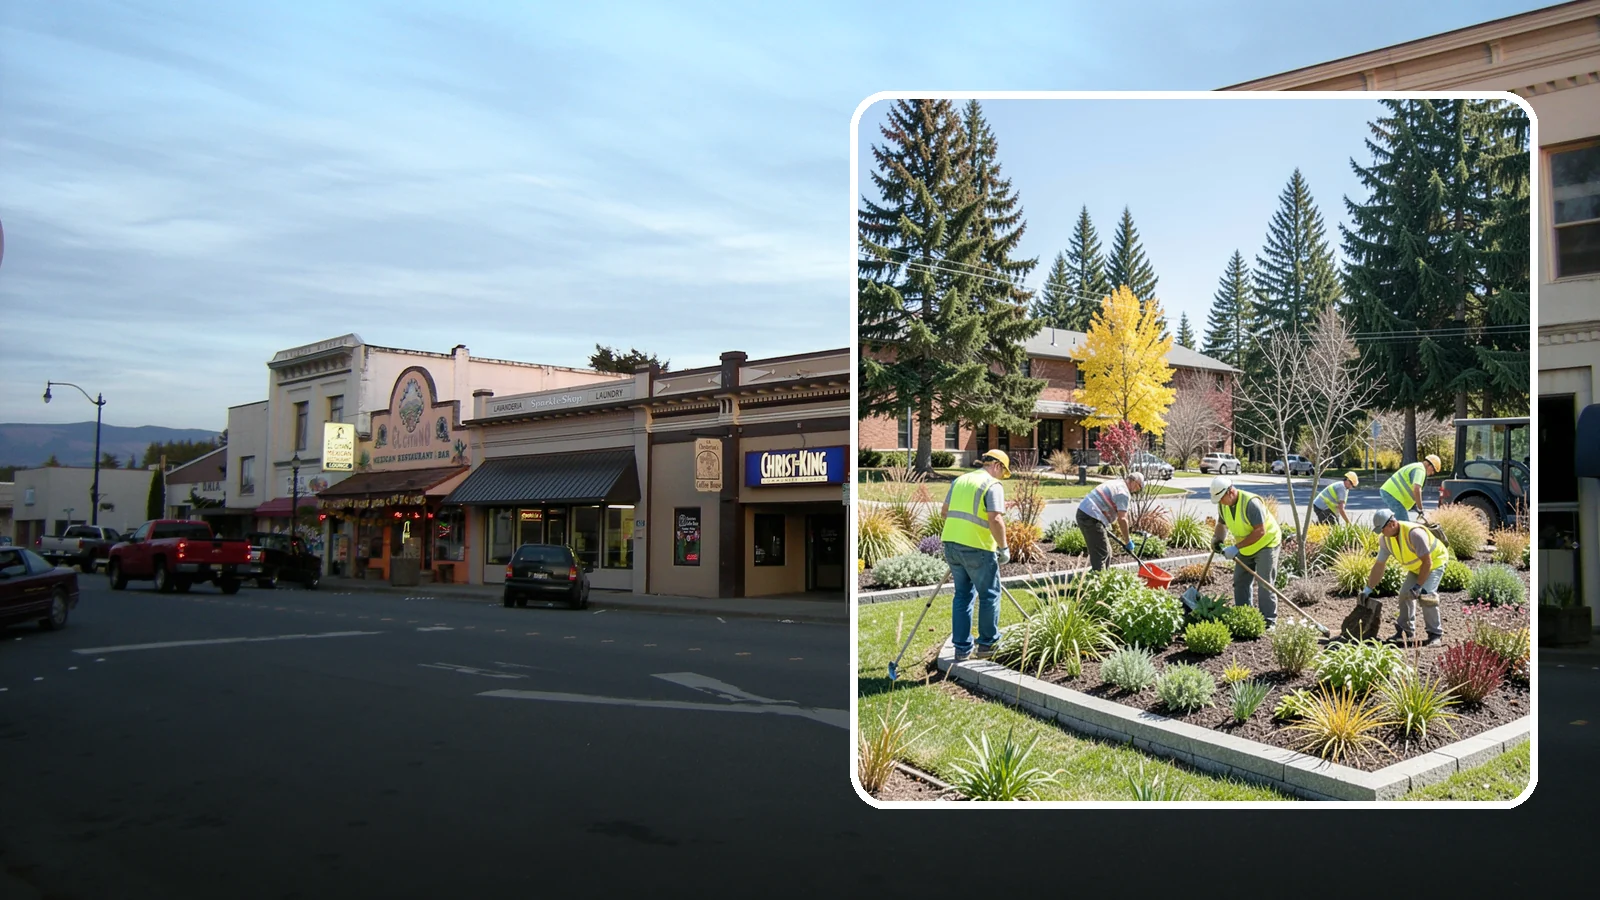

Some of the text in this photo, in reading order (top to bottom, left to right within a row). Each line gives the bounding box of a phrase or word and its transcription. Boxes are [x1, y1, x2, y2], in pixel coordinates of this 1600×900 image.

[493, 389, 623, 412] LAVANDERIA Sparkle Shop LAUNDRY
[373, 454, 396, 464] MEXICAN
[397, 451, 433, 462] RESTAURANT
[438, 450, 450, 458] BAR
[760, 450, 827, 478] CHRIST KING
